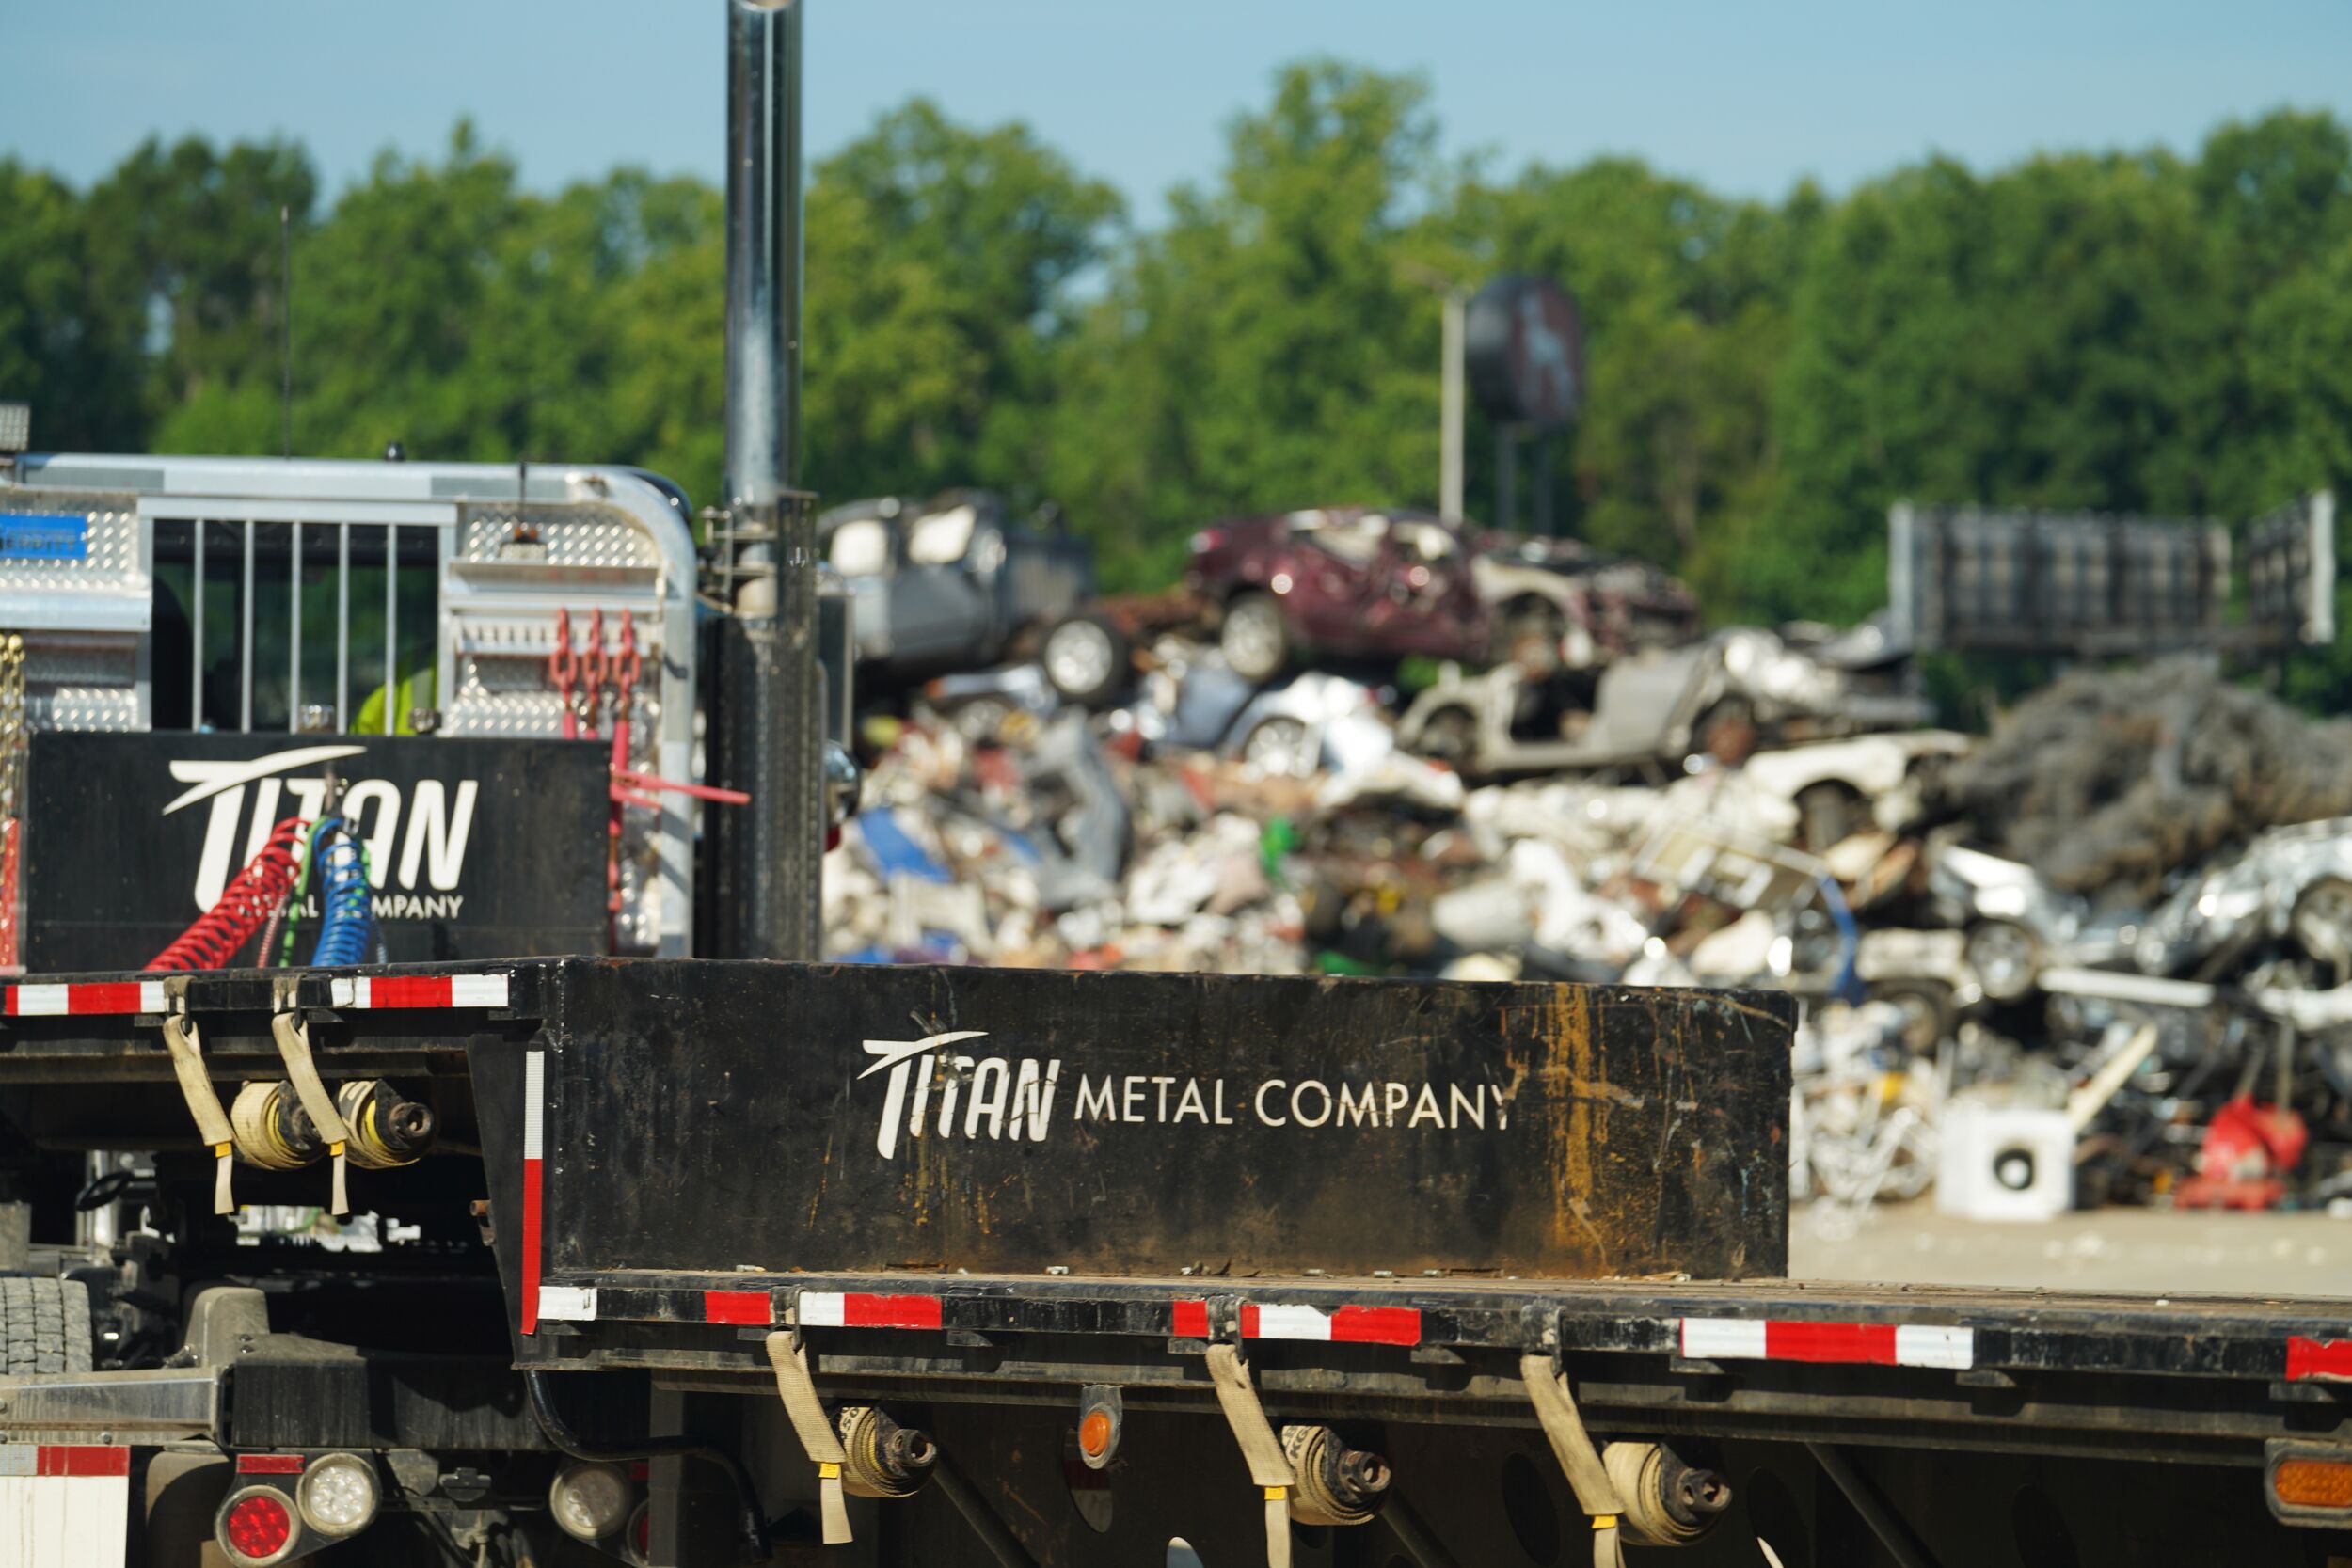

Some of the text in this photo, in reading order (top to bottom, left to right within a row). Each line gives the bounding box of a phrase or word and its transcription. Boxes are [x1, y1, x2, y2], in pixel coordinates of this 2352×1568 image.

[162, 745, 479, 915] TITAN
[333, 895, 464, 919] MPANY
[857, 1031, 1508, 1160] TITAN METAL COMPANY
